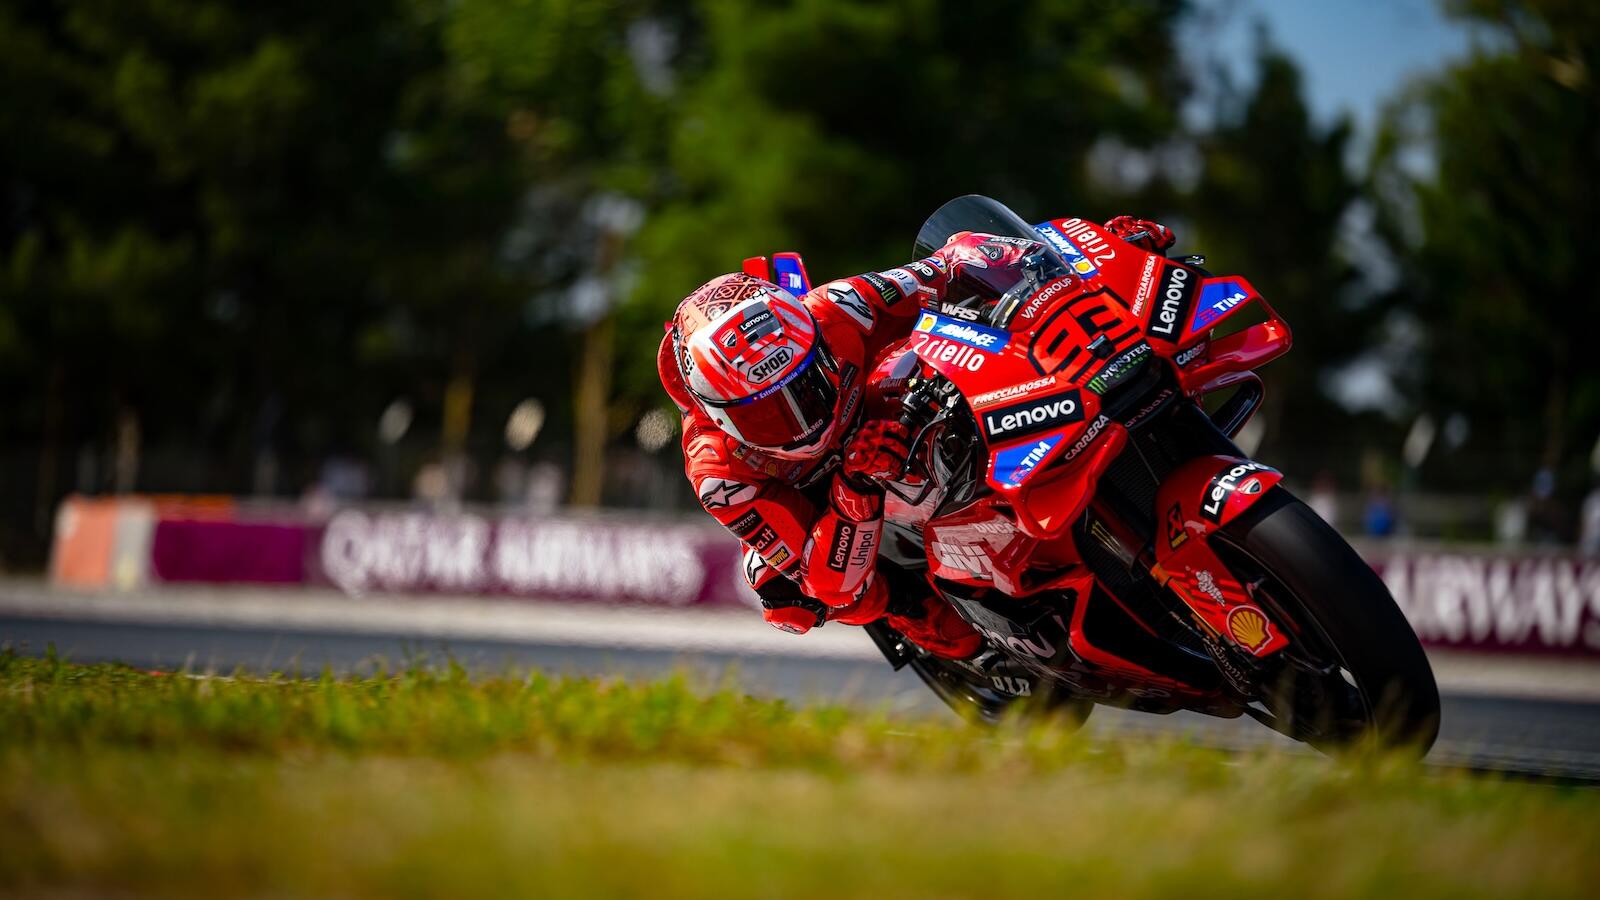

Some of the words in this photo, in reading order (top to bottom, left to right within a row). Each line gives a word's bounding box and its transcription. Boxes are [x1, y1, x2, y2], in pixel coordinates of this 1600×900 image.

[941, 302, 981, 321] WRS
[1021, 277, 1073, 319] VARGROUP
[1152, 268, 1188, 335] Lenovo
[1213, 292, 1247, 312] TIM
[740, 312, 769, 331] Lenovo
[752, 348, 791, 381] SHOEI
[1100, 342, 1151, 381] MONSTER
[973, 376, 1056, 405] FRECCIAROSSA
[793, 419, 824, 442] Insta360
[987, 399, 1076, 435] Lenovo
[1021, 441, 1051, 469] TIM
[1064, 414, 1110, 461] CARRERA
[1204, 462, 1268, 515] Lenovo
[830, 526, 851, 569] Lenovo
[850, 530, 875, 568] Unipol
